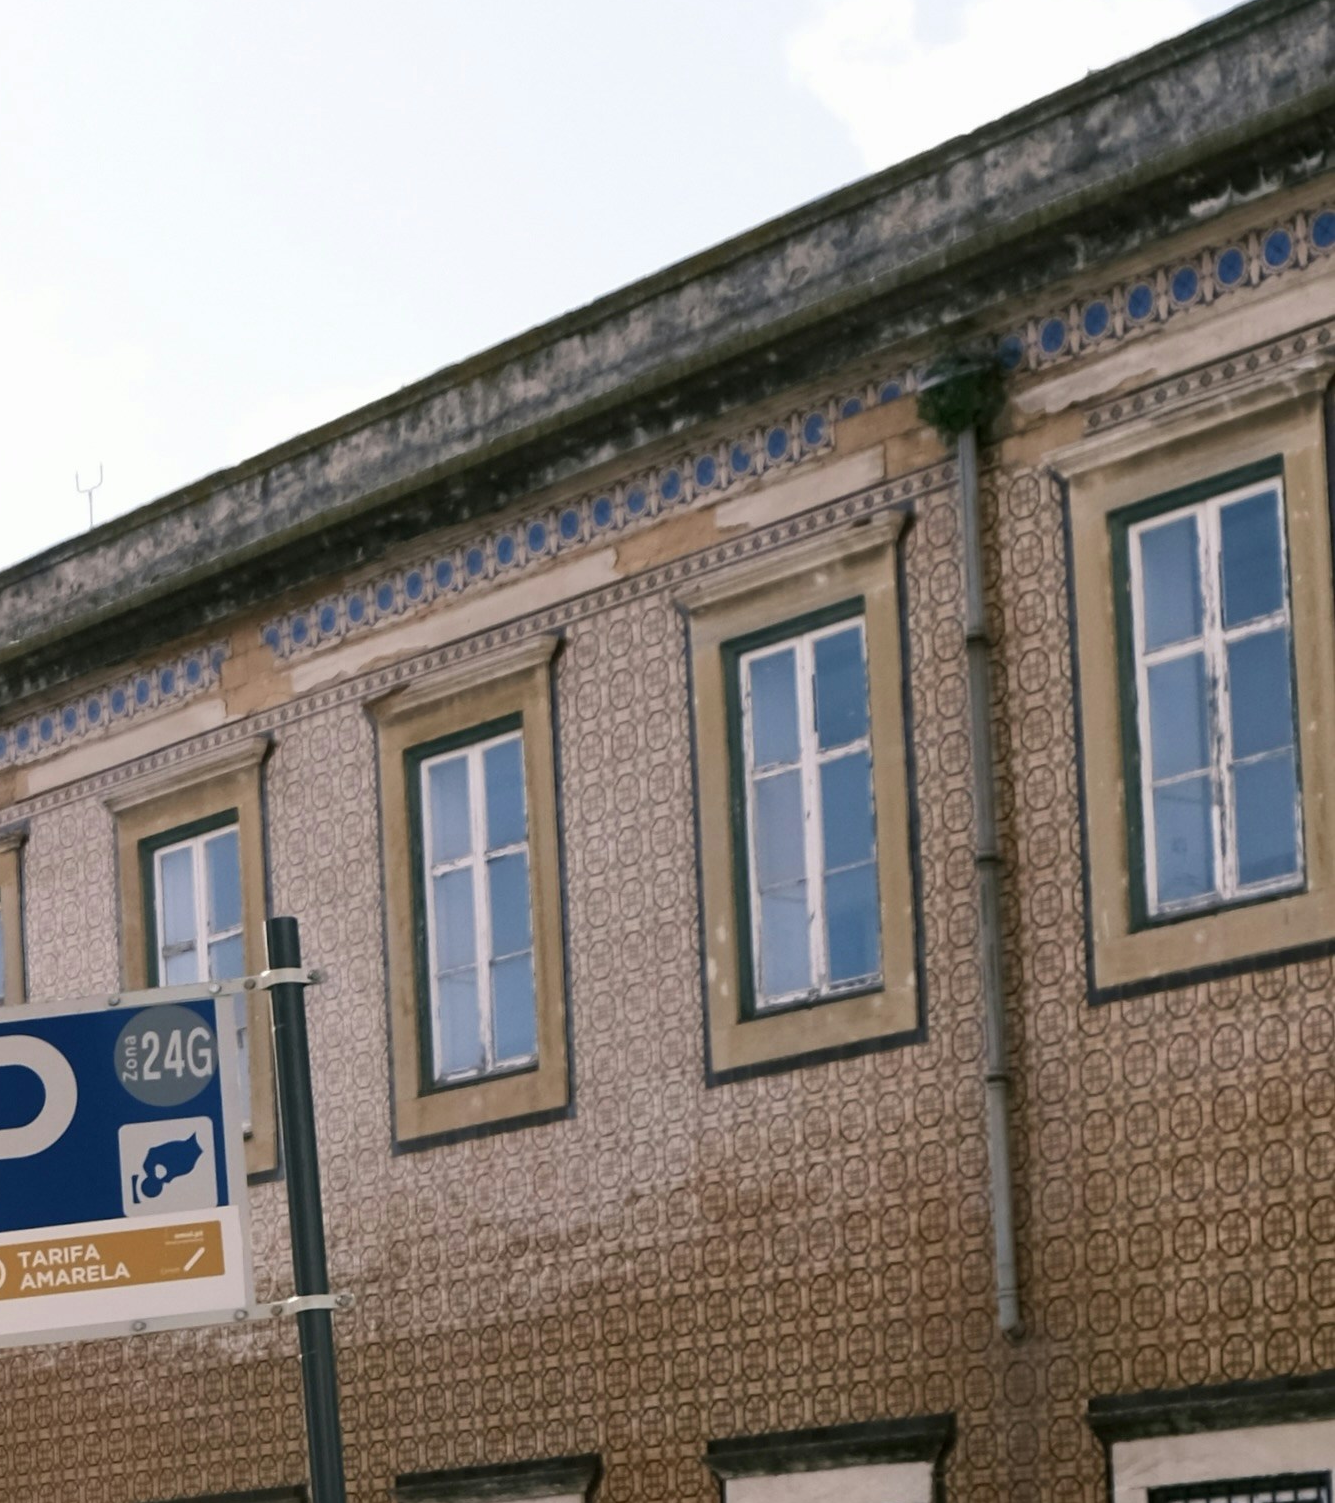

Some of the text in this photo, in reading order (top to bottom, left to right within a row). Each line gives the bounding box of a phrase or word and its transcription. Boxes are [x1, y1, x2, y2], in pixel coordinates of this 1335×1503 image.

[140, 1025, 213, 1081] 24G
[17, 1243, 101, 1268] TARIFA
[19, 1262, 131, 1291] AMARELA
